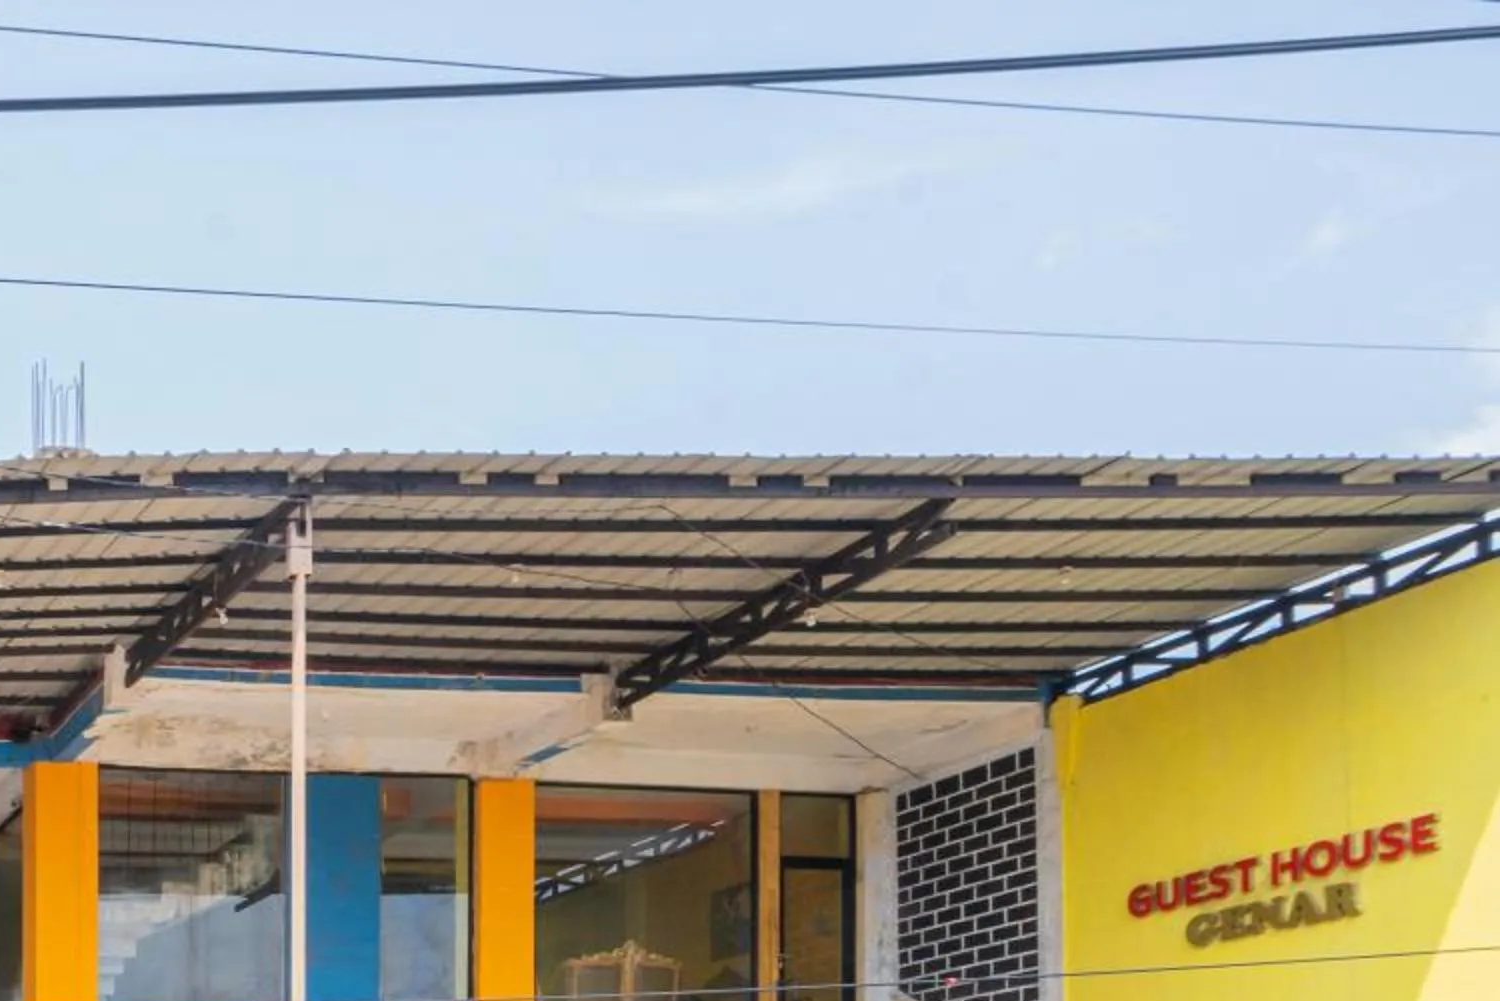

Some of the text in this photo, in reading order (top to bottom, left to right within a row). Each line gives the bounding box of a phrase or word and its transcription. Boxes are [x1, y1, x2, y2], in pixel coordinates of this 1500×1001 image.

[1128, 813, 1440, 918] GUEST HOUSE
[1186, 882, 1363, 948] GENAR
